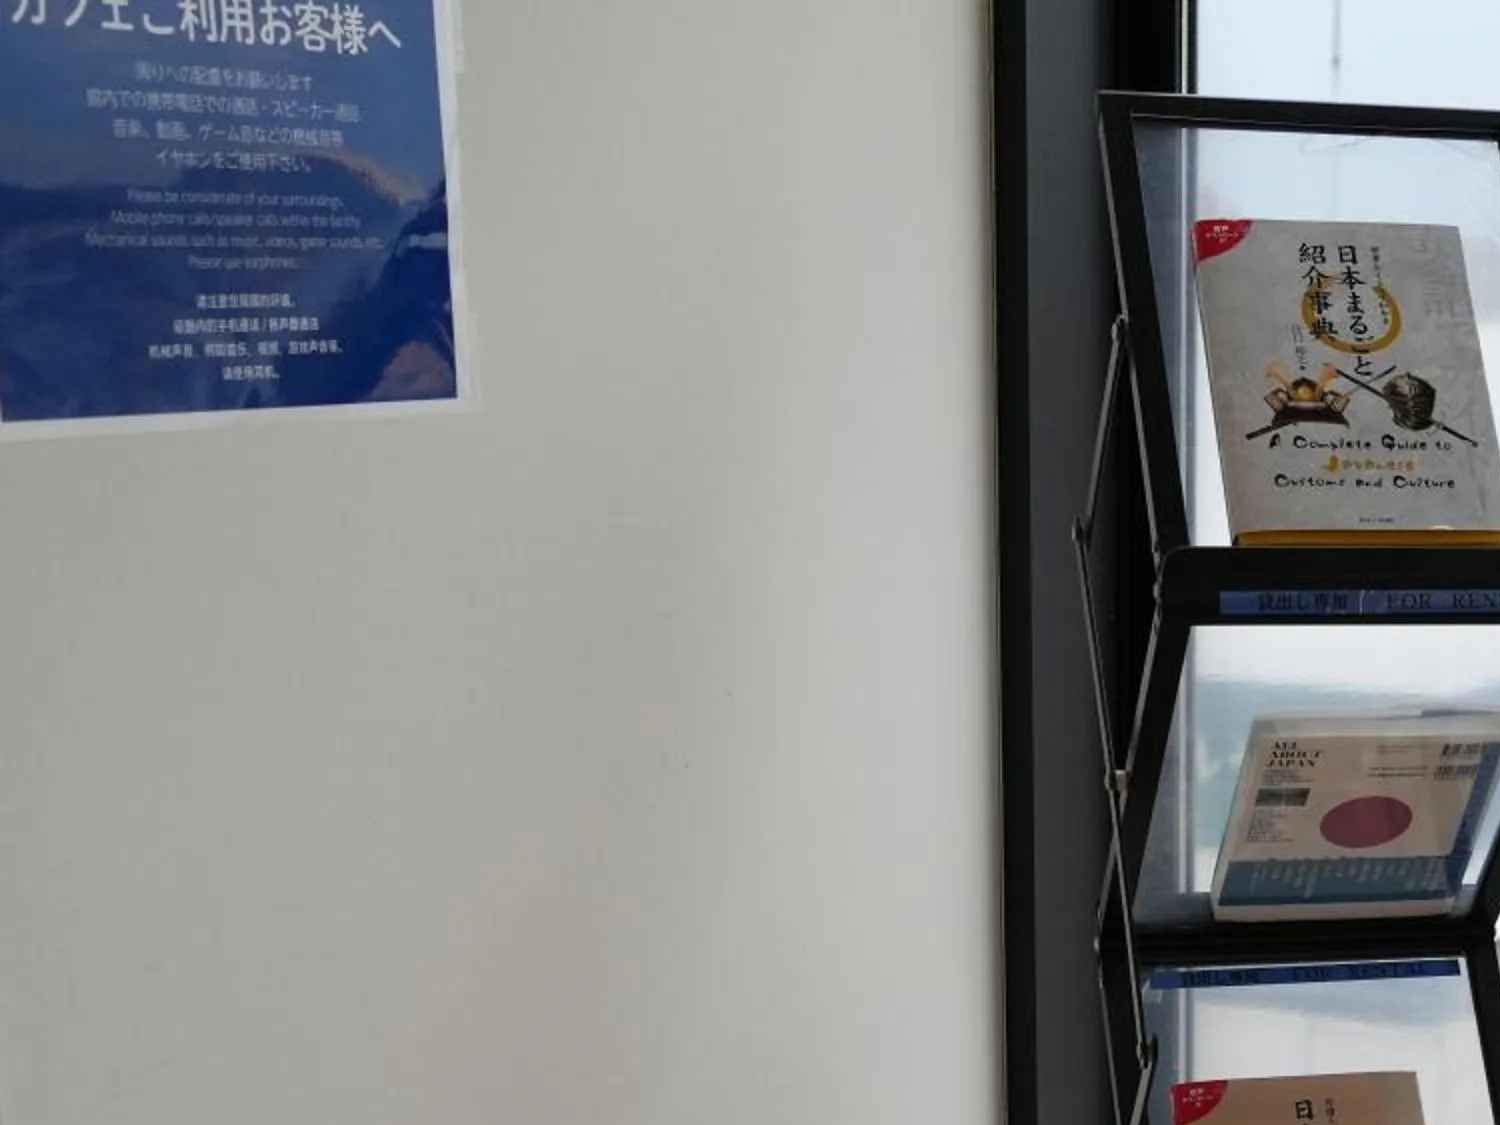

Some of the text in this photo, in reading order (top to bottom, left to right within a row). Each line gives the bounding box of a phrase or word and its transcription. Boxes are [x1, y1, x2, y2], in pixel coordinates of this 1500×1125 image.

[1298, 242, 1338, 343] 紹介事典
[1337, 244, 1374, 376] 日本まるごと
[1269, 433, 1281, 449] A
[1293, 434, 1372, 452] Complete
[1386, 593, 1432, 611] FOR
